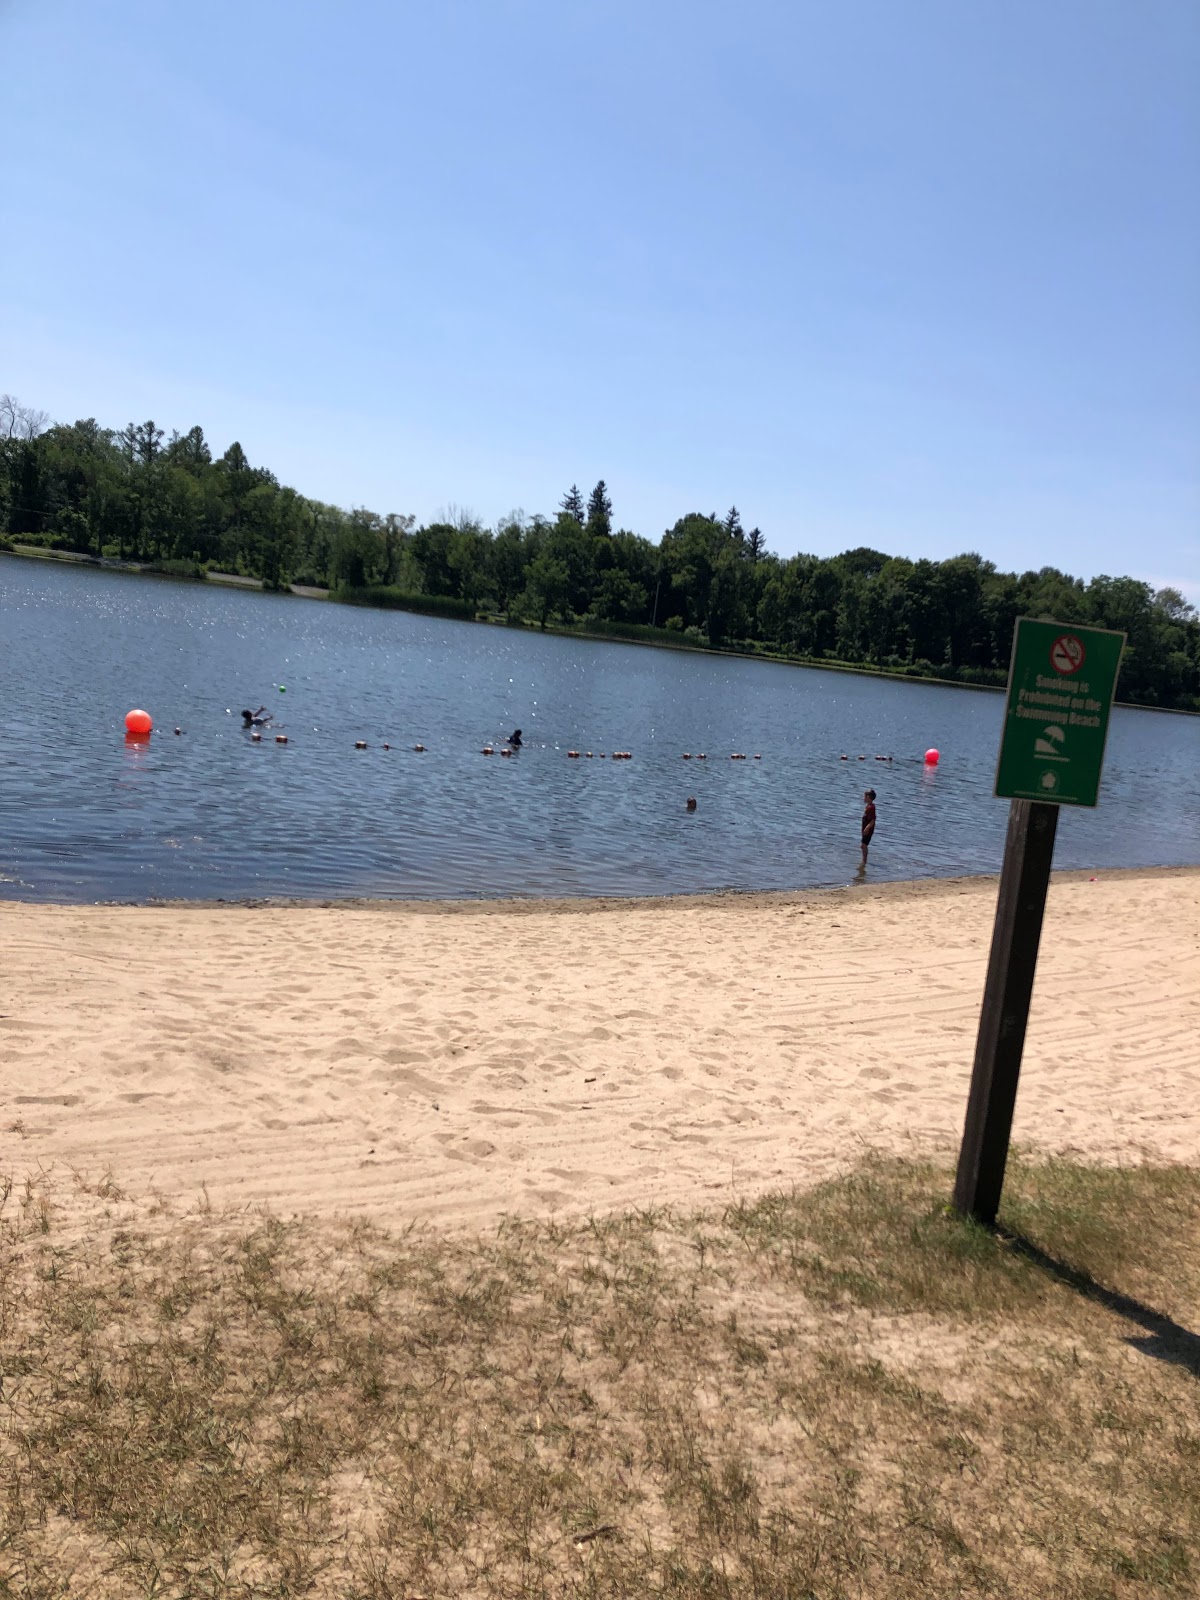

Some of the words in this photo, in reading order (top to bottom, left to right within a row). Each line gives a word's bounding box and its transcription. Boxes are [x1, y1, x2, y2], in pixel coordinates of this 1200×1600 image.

[1019, 688, 1071, 708] Prohibited
[1071, 698, 1084, 709] on
[1085, 699, 1102, 711] the
[1069, 712, 1100, 727] Beach
